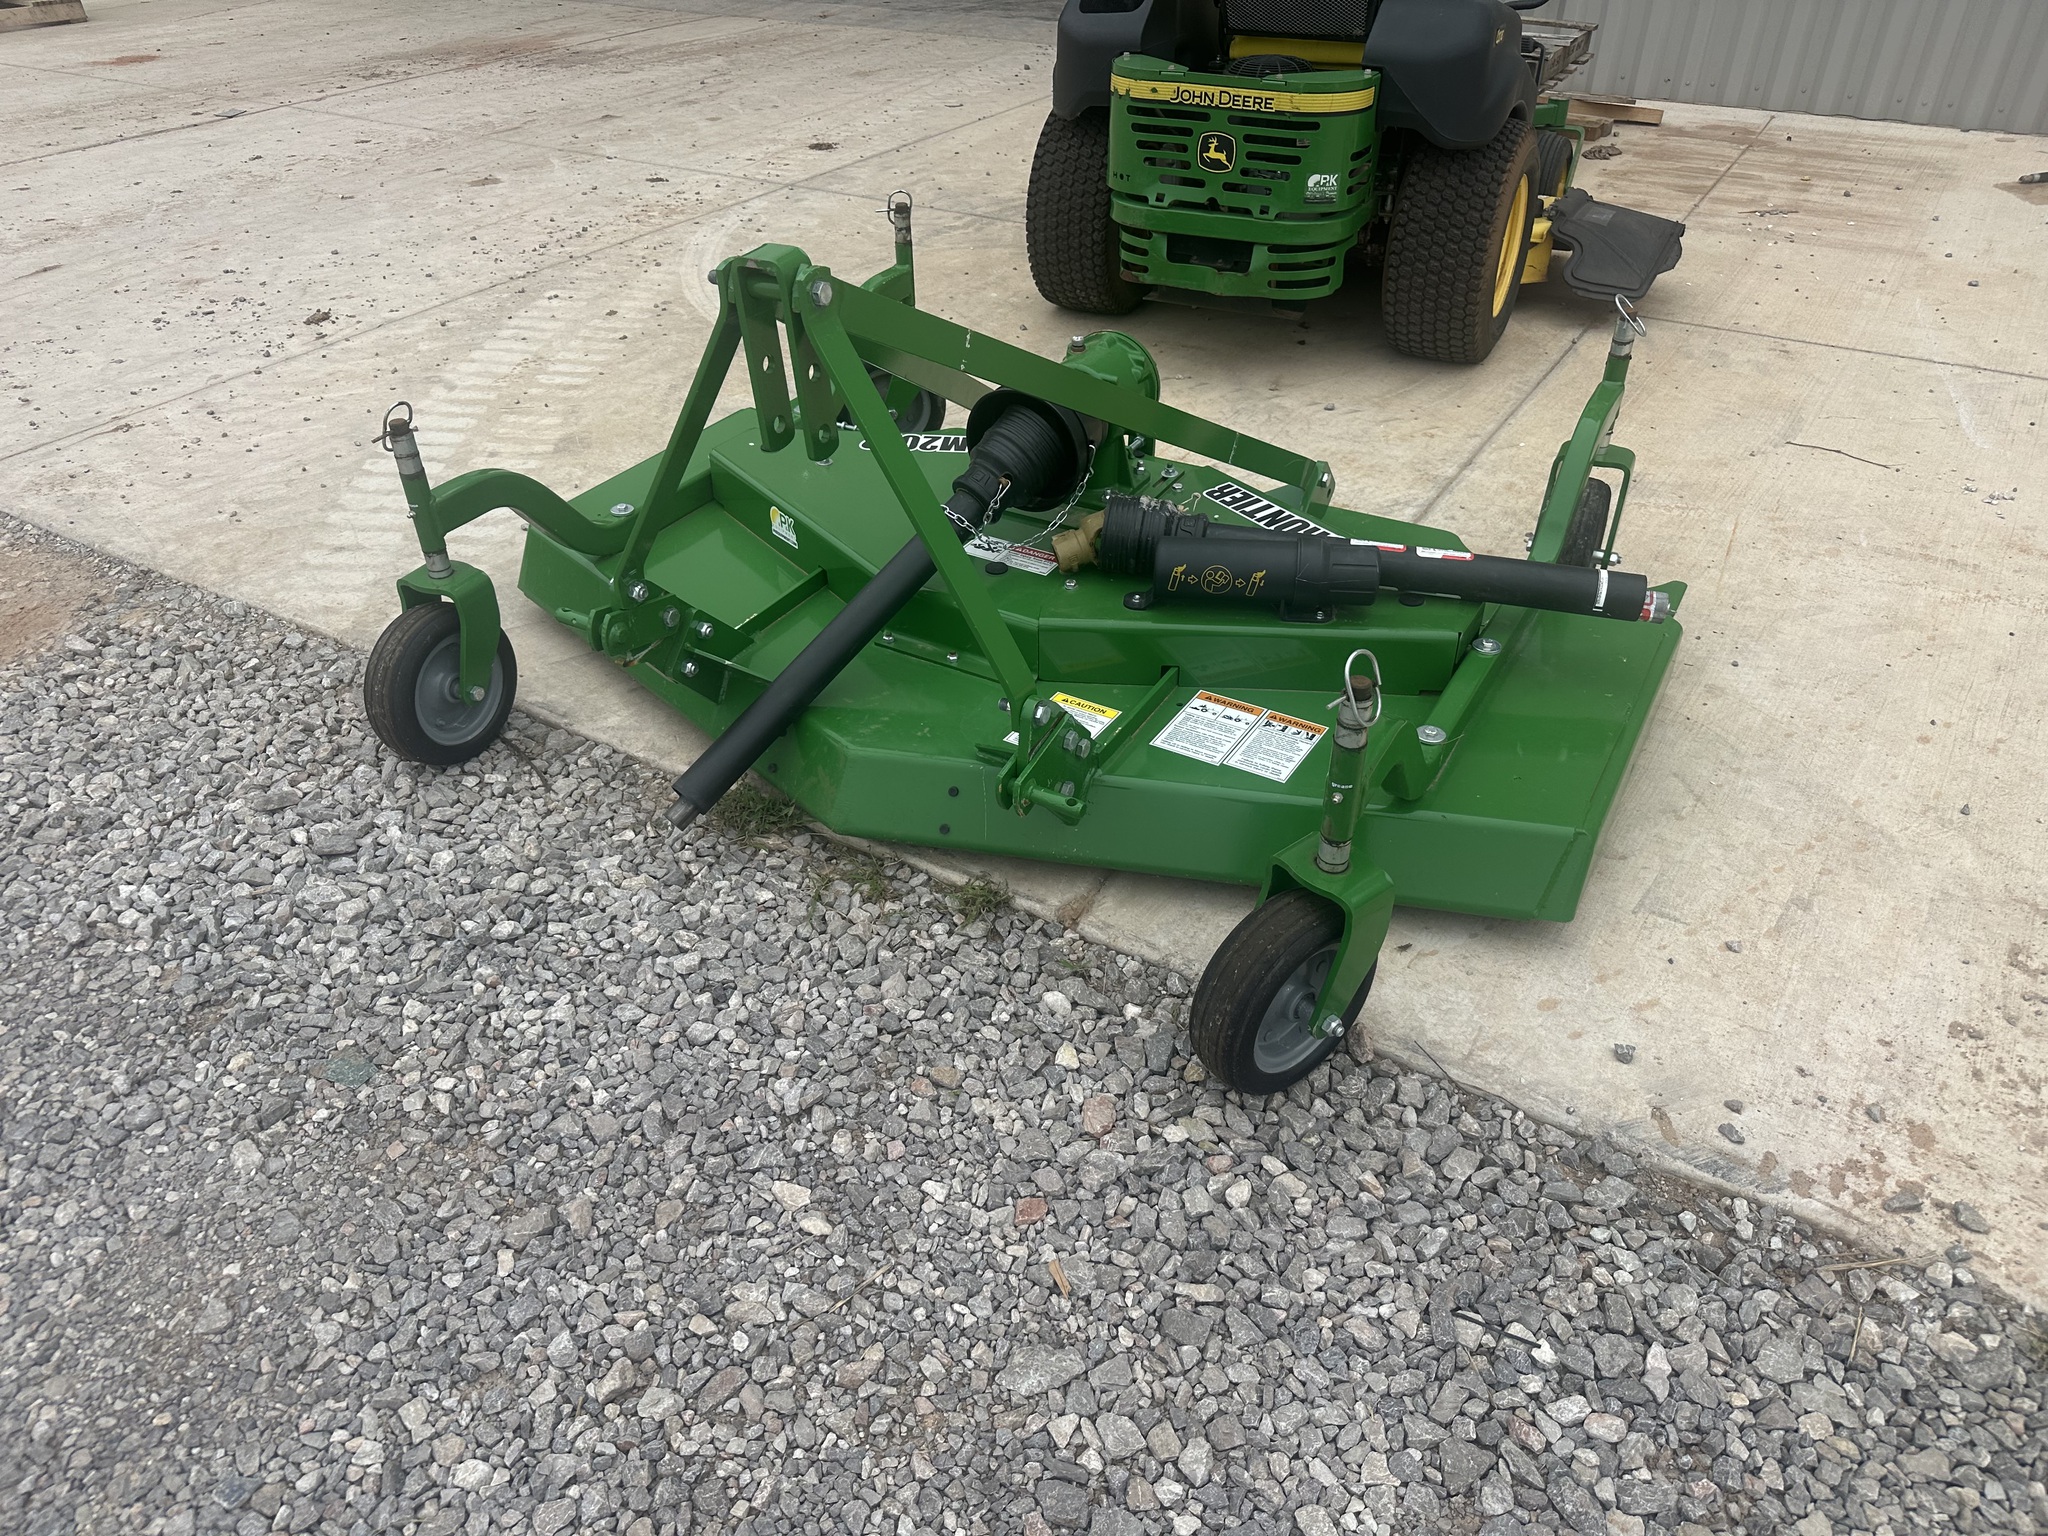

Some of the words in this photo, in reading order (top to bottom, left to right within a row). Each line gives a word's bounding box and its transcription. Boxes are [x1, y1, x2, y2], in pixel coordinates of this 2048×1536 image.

[1171, 86, 1214, 105] JOHN
[1219, 91, 1275, 110] DEERE
[1112, 171, 1131, 182] HOT
[1203, 483, 1334, 537] ONTIER
[1021, 547, 1056, 560] DANGER
[1069, 699, 1108, 714] CAUTION
[1213, 697, 1255, 713] WARNING
[1279, 717, 1322, 733] WARNING
